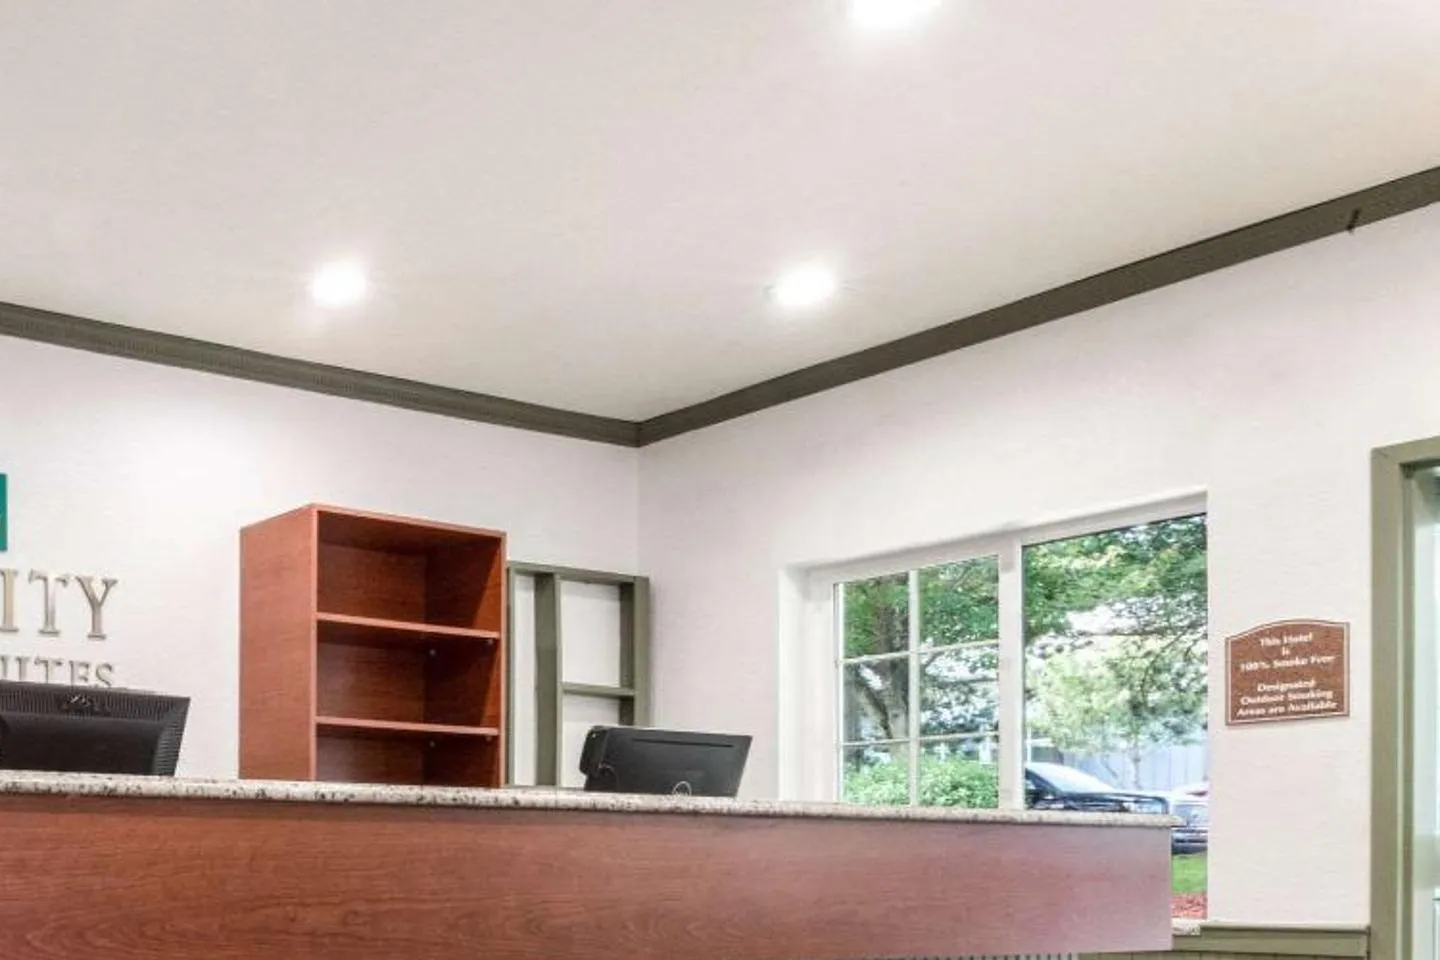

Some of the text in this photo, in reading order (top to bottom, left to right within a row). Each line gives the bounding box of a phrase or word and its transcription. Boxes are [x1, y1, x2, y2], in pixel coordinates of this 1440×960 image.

[1260, 632, 1313, 647] This Hotel
[1273, 657, 1308, 668] Smoke
[1257, 679, 1316, 693] Designated
[1240, 690, 1333, 706] Outdoor Smoking
[1268, 706, 1285, 714] are
[1287, 700, 1339, 713] Available
